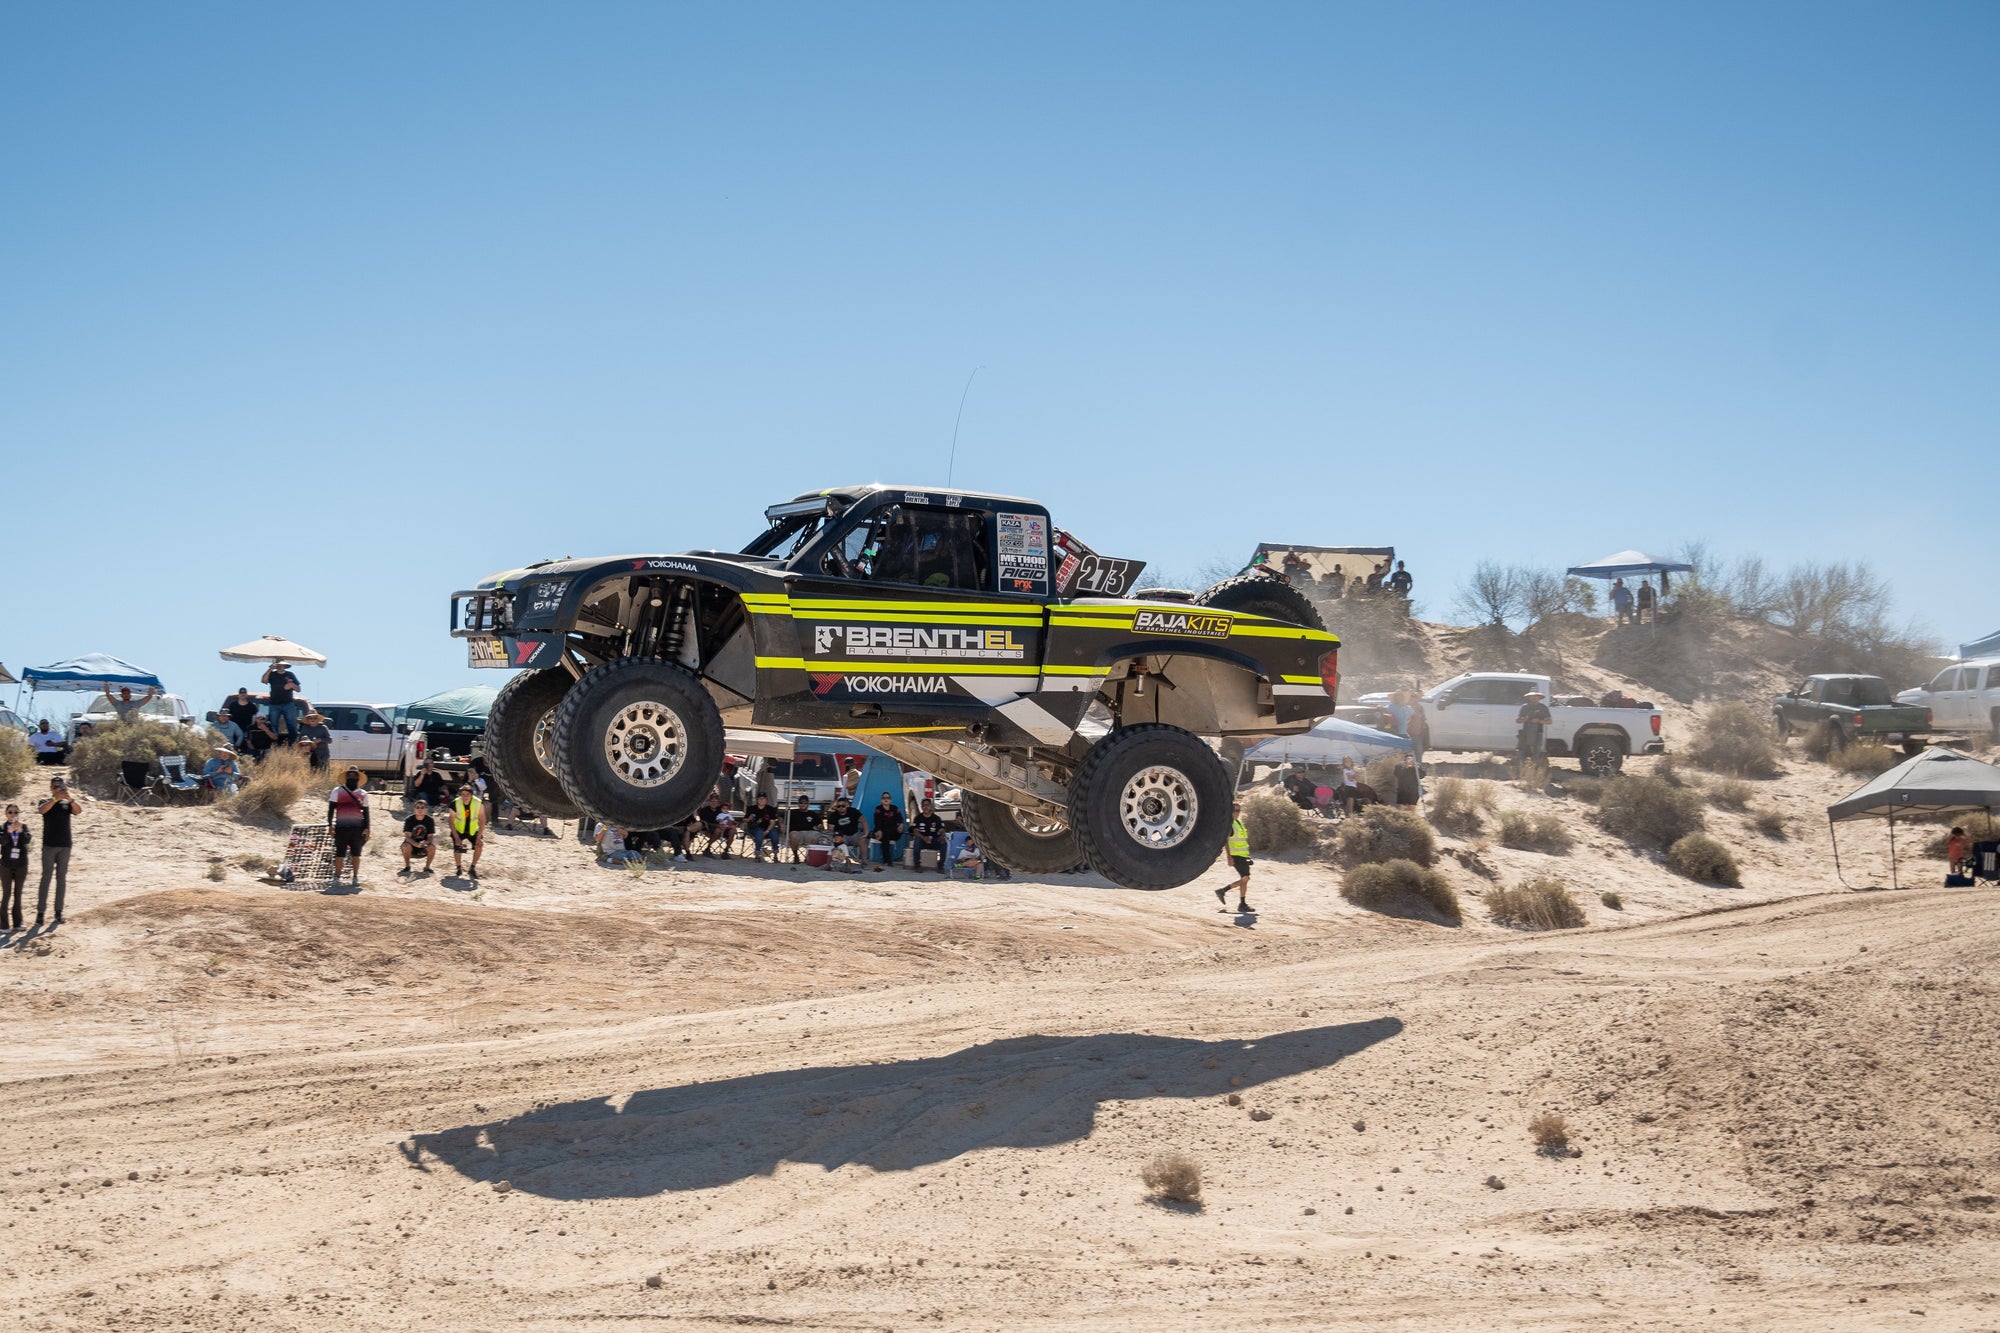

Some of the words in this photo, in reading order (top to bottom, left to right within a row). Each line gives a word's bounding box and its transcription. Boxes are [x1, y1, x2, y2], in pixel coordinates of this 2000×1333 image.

[1000, 554, 1046, 565] METHOD
[647, 560, 698, 573] YOKOHAMA
[1002, 568, 1046, 580] RIGID
[1076, 555, 1129, 596] 273
[1013, 579, 1033, 589] FOX
[1136, 612, 1230, 632] BAJAKITS
[846, 626, 1025, 649] BRENTHEL
[1184, 629, 1226, 637] INDUSTRIES
[843, 675, 948, 693] YOKOHAMA
